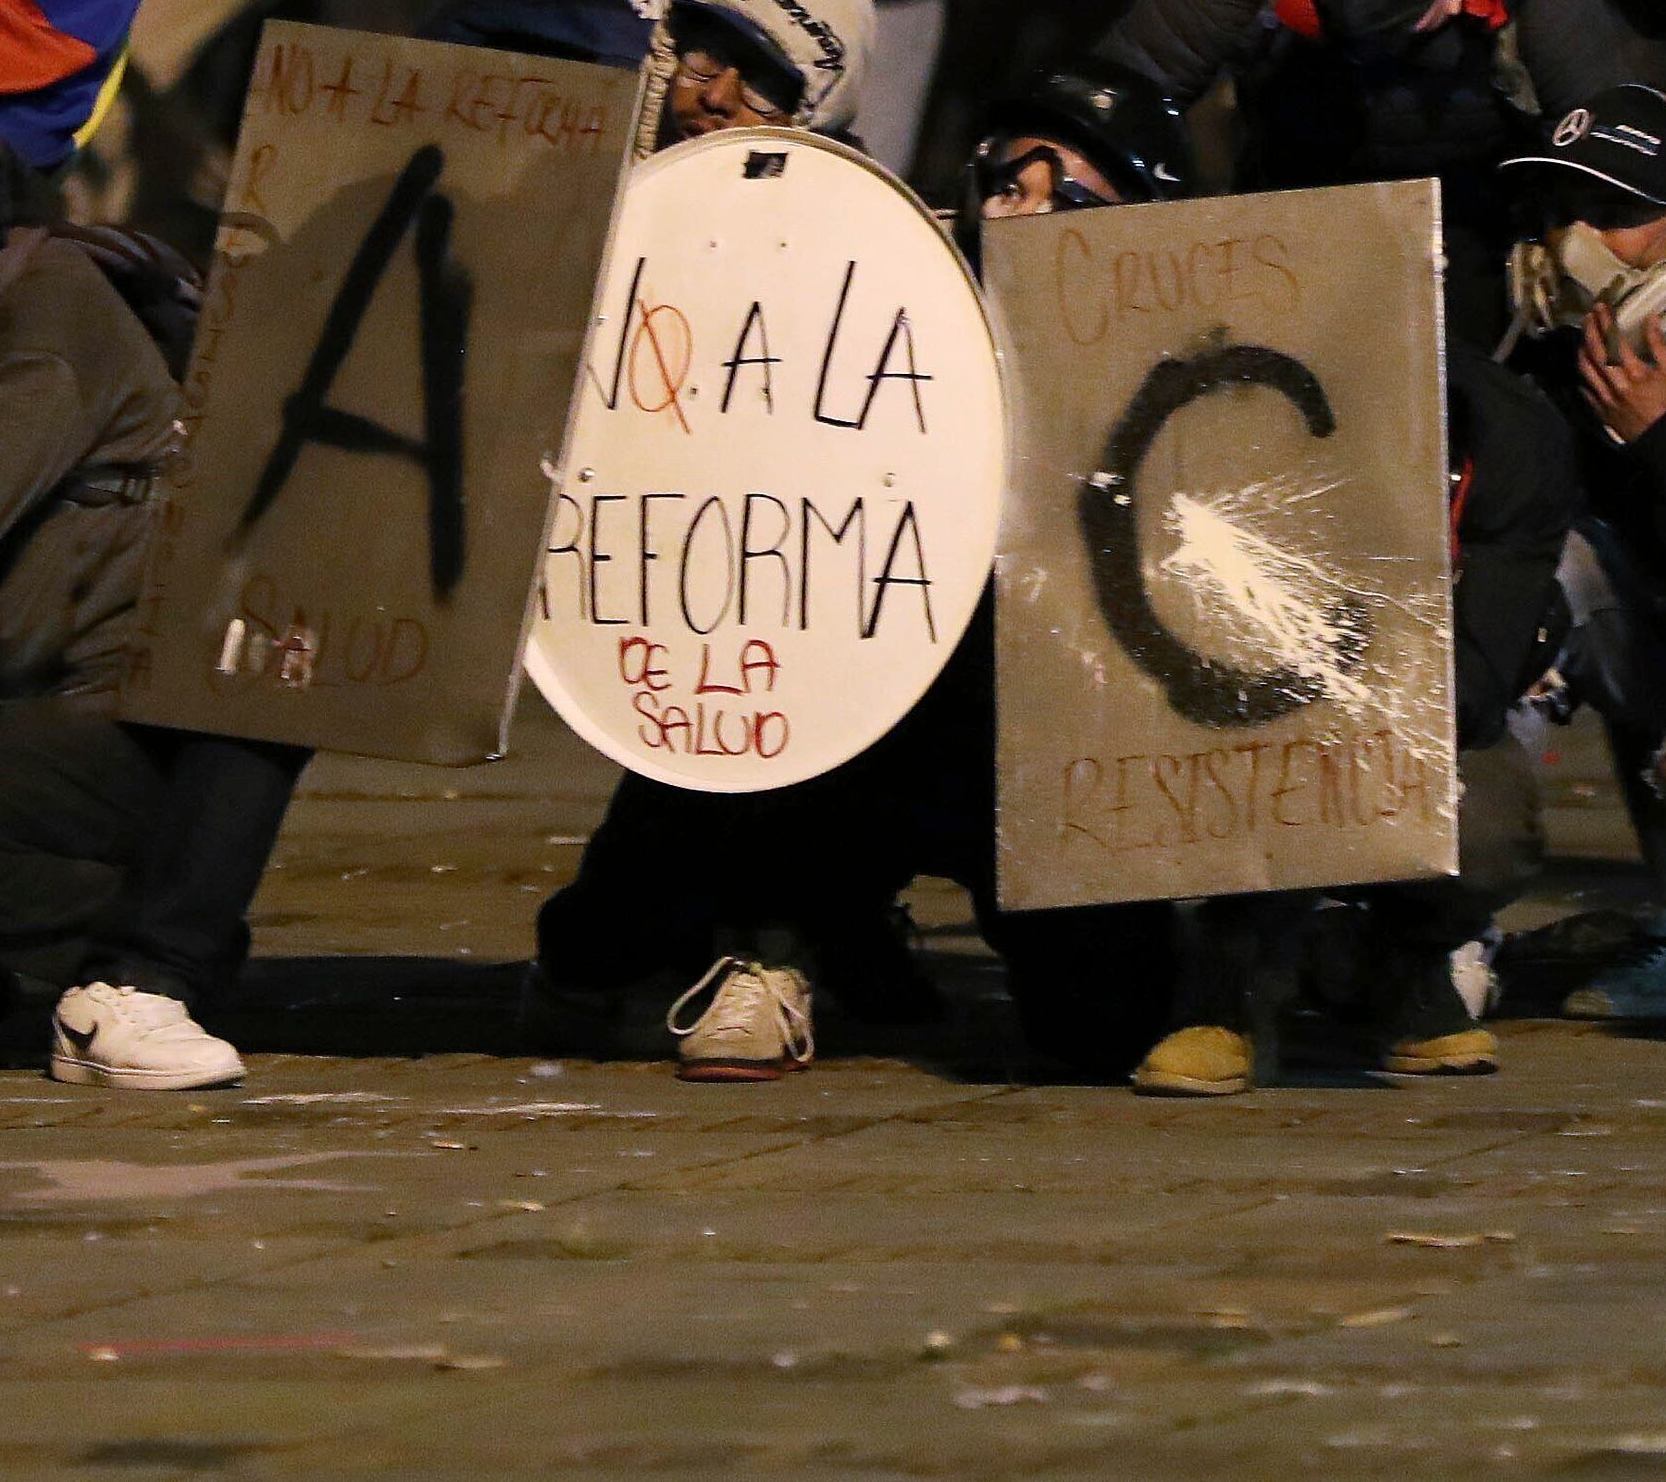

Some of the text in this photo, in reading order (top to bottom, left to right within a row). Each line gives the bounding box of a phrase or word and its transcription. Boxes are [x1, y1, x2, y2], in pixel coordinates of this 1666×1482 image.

[1052, 228, 1302, 345] CRUCES
[721, 301, 782, 414] A
[814, 260, 933, 434] LA
[539, 493, 937, 642] REFORMA
[618, 636, 781, 695] DE LA
[632, 690, 789, 758] SALUD
